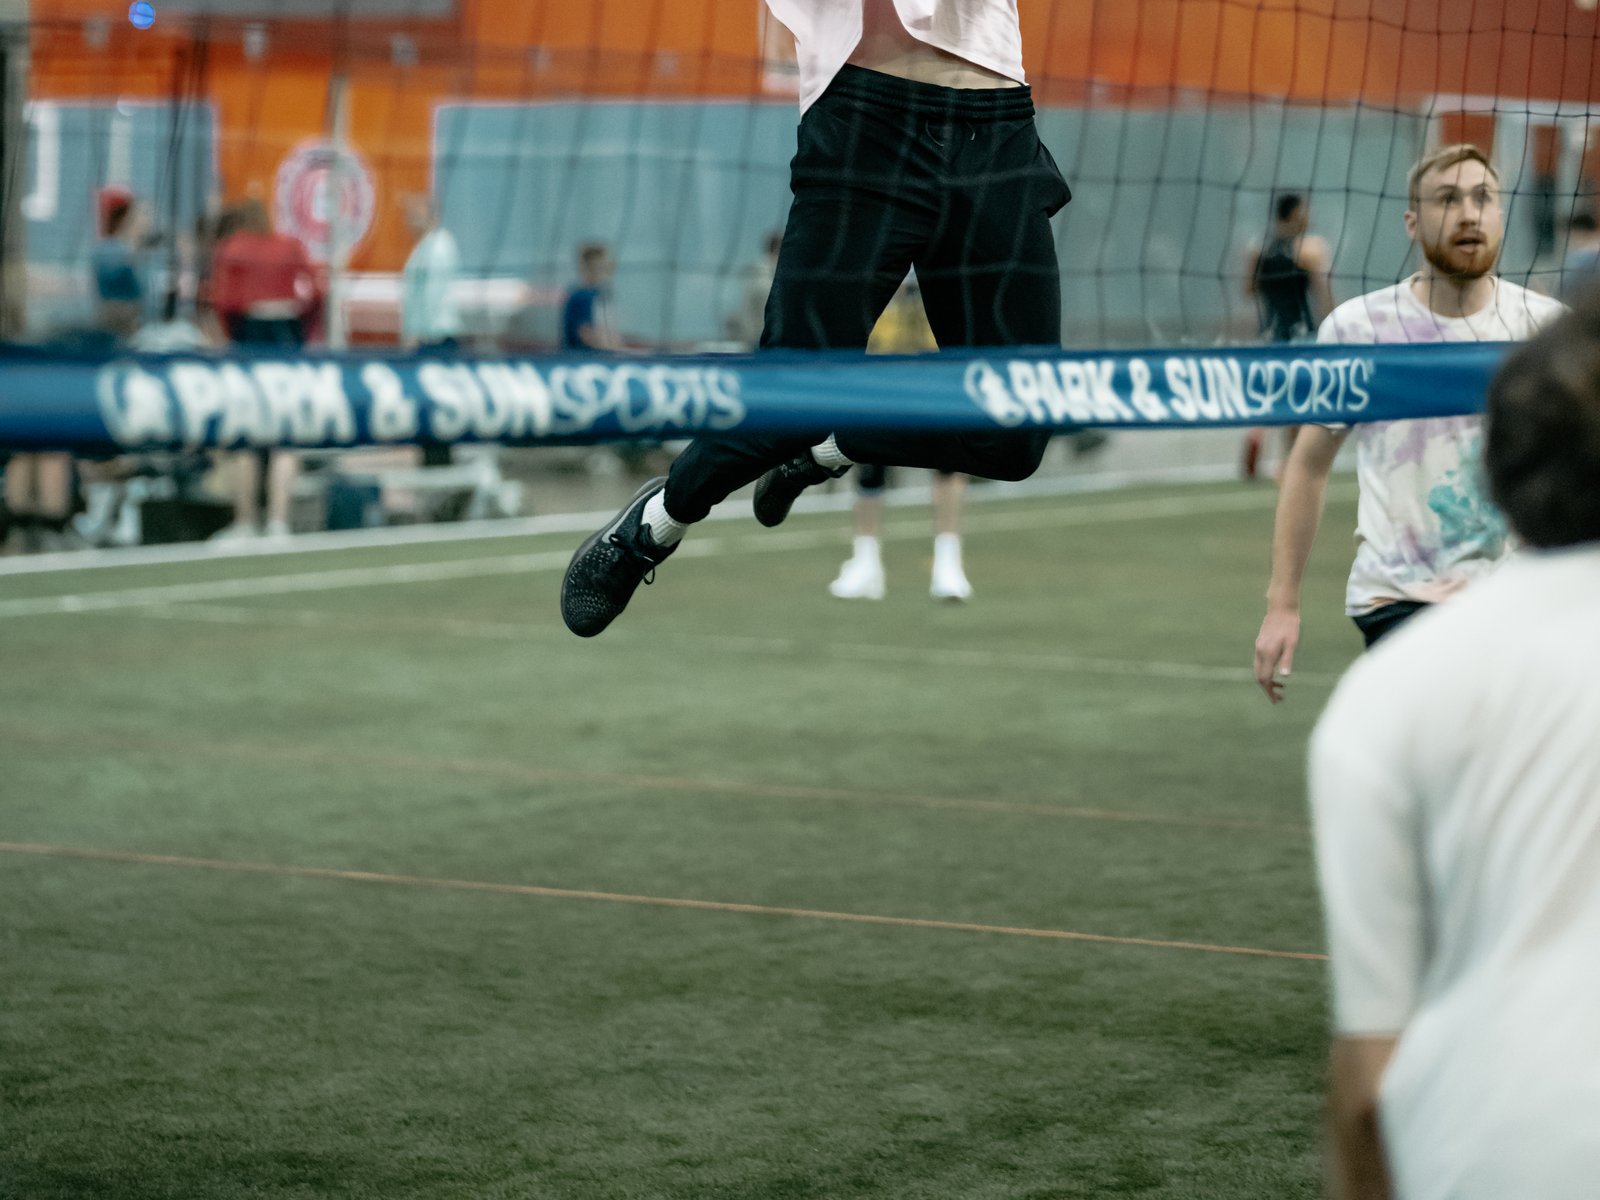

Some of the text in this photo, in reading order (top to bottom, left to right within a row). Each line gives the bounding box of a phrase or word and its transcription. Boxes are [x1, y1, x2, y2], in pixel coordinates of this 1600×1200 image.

[168, 360, 356, 443] PARK
[359, 361, 419, 442] &
[1007, 359, 1136, 424] PARK
[1128, 358, 1170, 422] &
